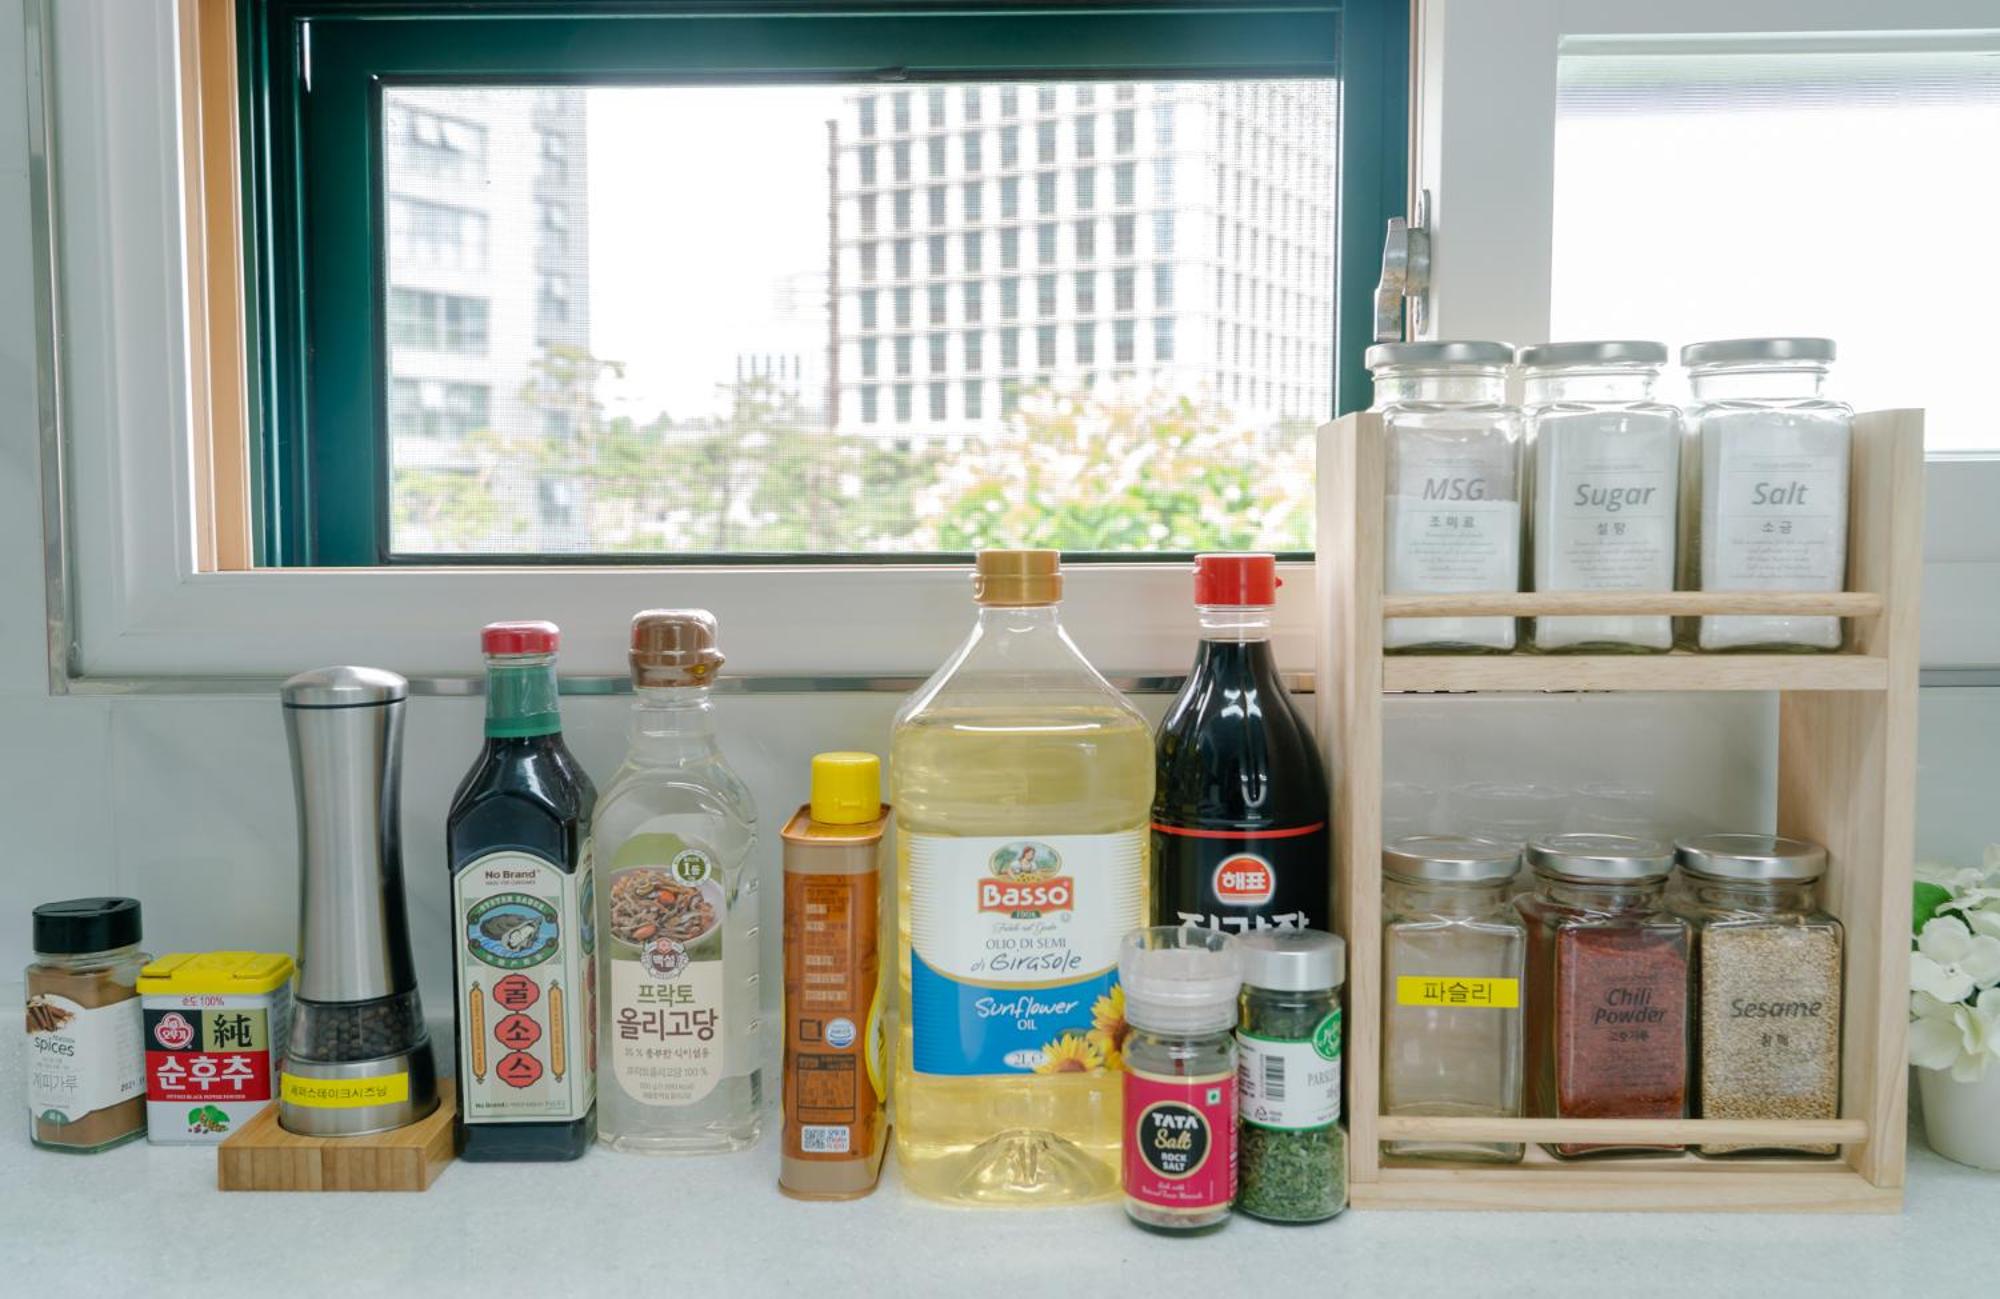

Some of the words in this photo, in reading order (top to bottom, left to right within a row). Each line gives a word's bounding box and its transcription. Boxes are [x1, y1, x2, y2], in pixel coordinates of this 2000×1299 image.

[1422, 478, 1487, 501] MSG
[1574, 483, 1656, 512] Sugar
[1751, 481, 1808, 505] Salt
[1761, 520, 1793, 534] 소금
[485, 871, 501, 879] No
[503, 869, 536, 878] Brand
[1222, 872, 1265, 890] 해표
[982, 884, 1069, 907] Basso
[986, 939, 1016, 949] OLIO
[1020, 939, 1033, 949] DI
[1037, 938, 1066, 949] SEMI
[971, 959, 984, 972] di
[990, 949, 1082, 973] Girasole
[201, 996, 225, 1007] 100%
[637, 984, 695, 1007] 프락토
[1424, 982, 1492, 1003] 파슬리
[1606, 987, 1653, 1006] Chili
[975, 996, 1079, 1018] Sunflower
[1594, 1006, 1666, 1025] Powder
[1730, 999, 1823, 1018] Sesame
[213, 1013, 253, 1048] 純
[617, 1008, 719, 1041] 올리고당
[1017, 1020, 1037, 1031] OIL
[33, 1036, 75, 1057] spices
[157, 1055, 254, 1090] 순후추
[1152, 1112, 1199, 1129] TATA
[1154, 1129, 1192, 1149] Salt
[1161, 1153, 1187, 1162] ROCK
[1163, 1162, 1185, 1171] SALT
